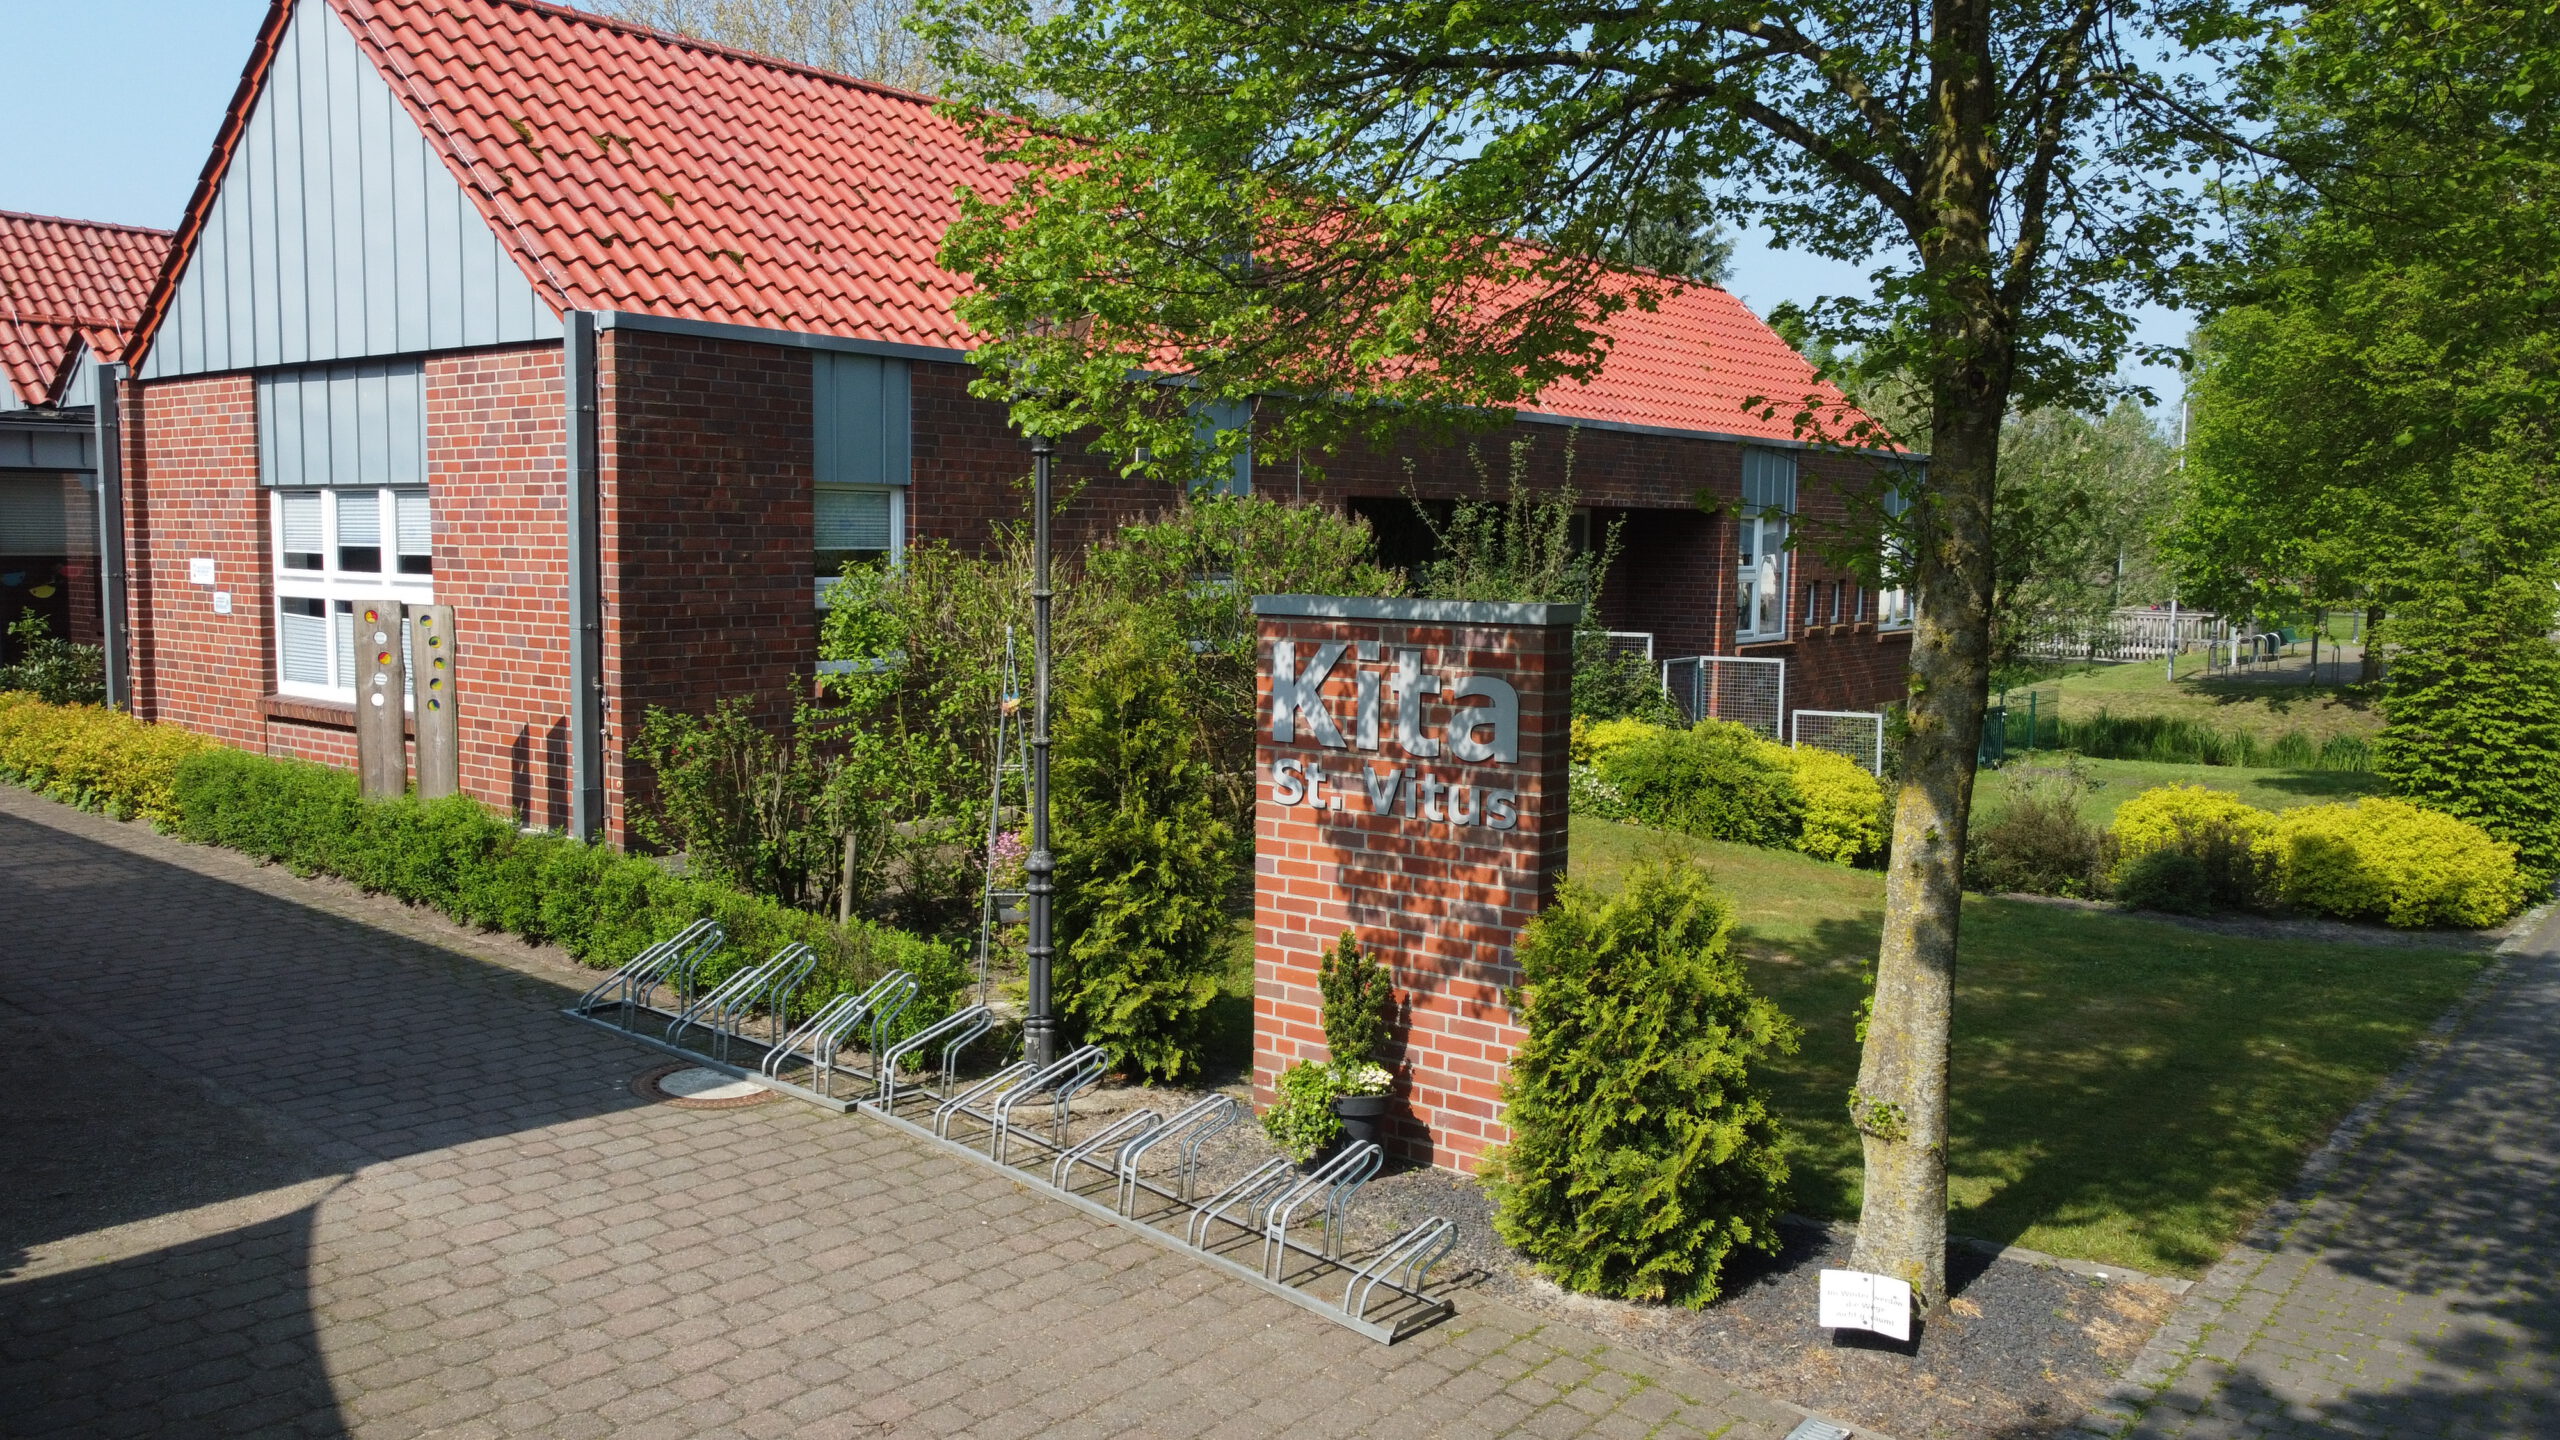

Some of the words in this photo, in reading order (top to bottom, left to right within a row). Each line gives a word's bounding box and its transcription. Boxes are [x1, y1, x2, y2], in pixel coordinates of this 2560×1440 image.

[1272, 640, 1519, 764] Kita
[1271, 757, 1342, 811] St.
[1363, 766, 1517, 829] Vitus
